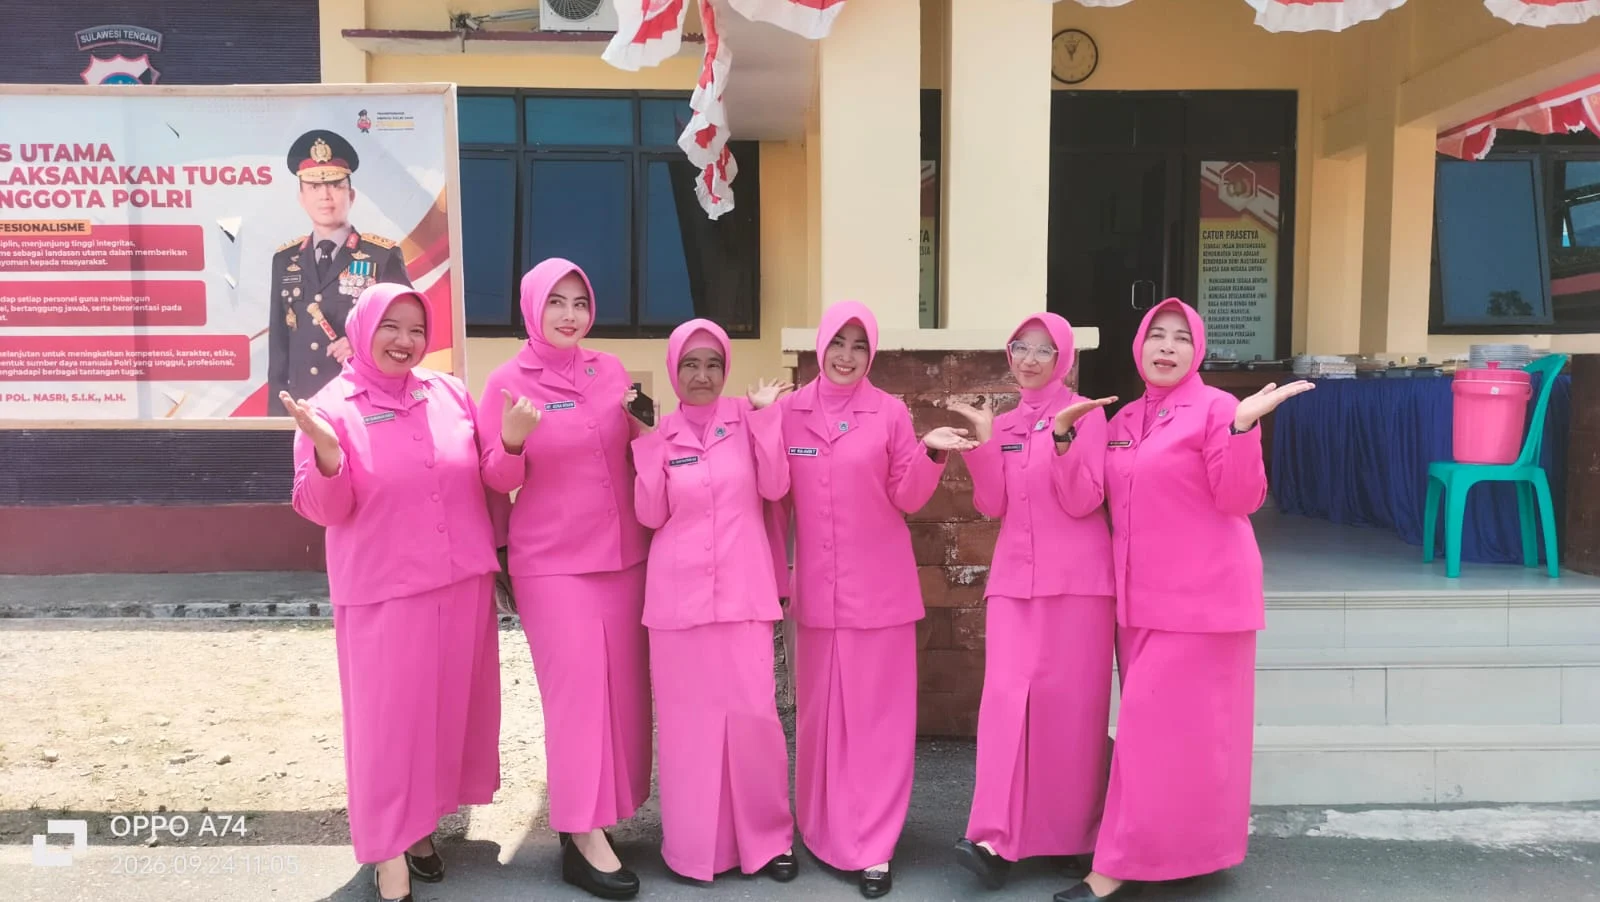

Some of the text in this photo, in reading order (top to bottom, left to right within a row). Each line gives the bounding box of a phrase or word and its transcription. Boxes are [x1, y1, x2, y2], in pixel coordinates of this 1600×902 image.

[80, 30, 157, 44] SULAWESI TENGAH
[20, 143, 116, 162] UTAMA
[182, 165, 273, 185] TUGAS
[112, 189, 192, 208] POLRI
[1202, 230, 1259, 240] CATUR PRASETYA
[21, 239, 70, 249] menjunjung
[71, 239, 95, 249] tinggi
[12, 249, 43, 258] sebagai
[134, 248, 188, 256] memberikan
[0, 258, 108, 268] yoman kepada masyarakat.
[79, 296, 98, 304] guna
[100, 295, 150, 303] membangun
[10, 304, 63, 313] bertanggung
[161, 304, 182, 313] pada
[42, 349, 66, 358] untuk
[68, 349, 124, 359] meningkatkan
[176, 349, 213, 358] karakter,
[26, 359, 57, 367] sumber
[58, 359, 78, 368] daya
[132, 359, 153, 368] yang
[0, 367, 41, 377] nghadapi
[42, 368, 78, 377] berbagai
[79, 368, 120, 377] tantangan
[6, 392, 31, 402] POL.
[33, 392, 69, 403] NASRI,
[104, 392, 127, 402] M.H.
